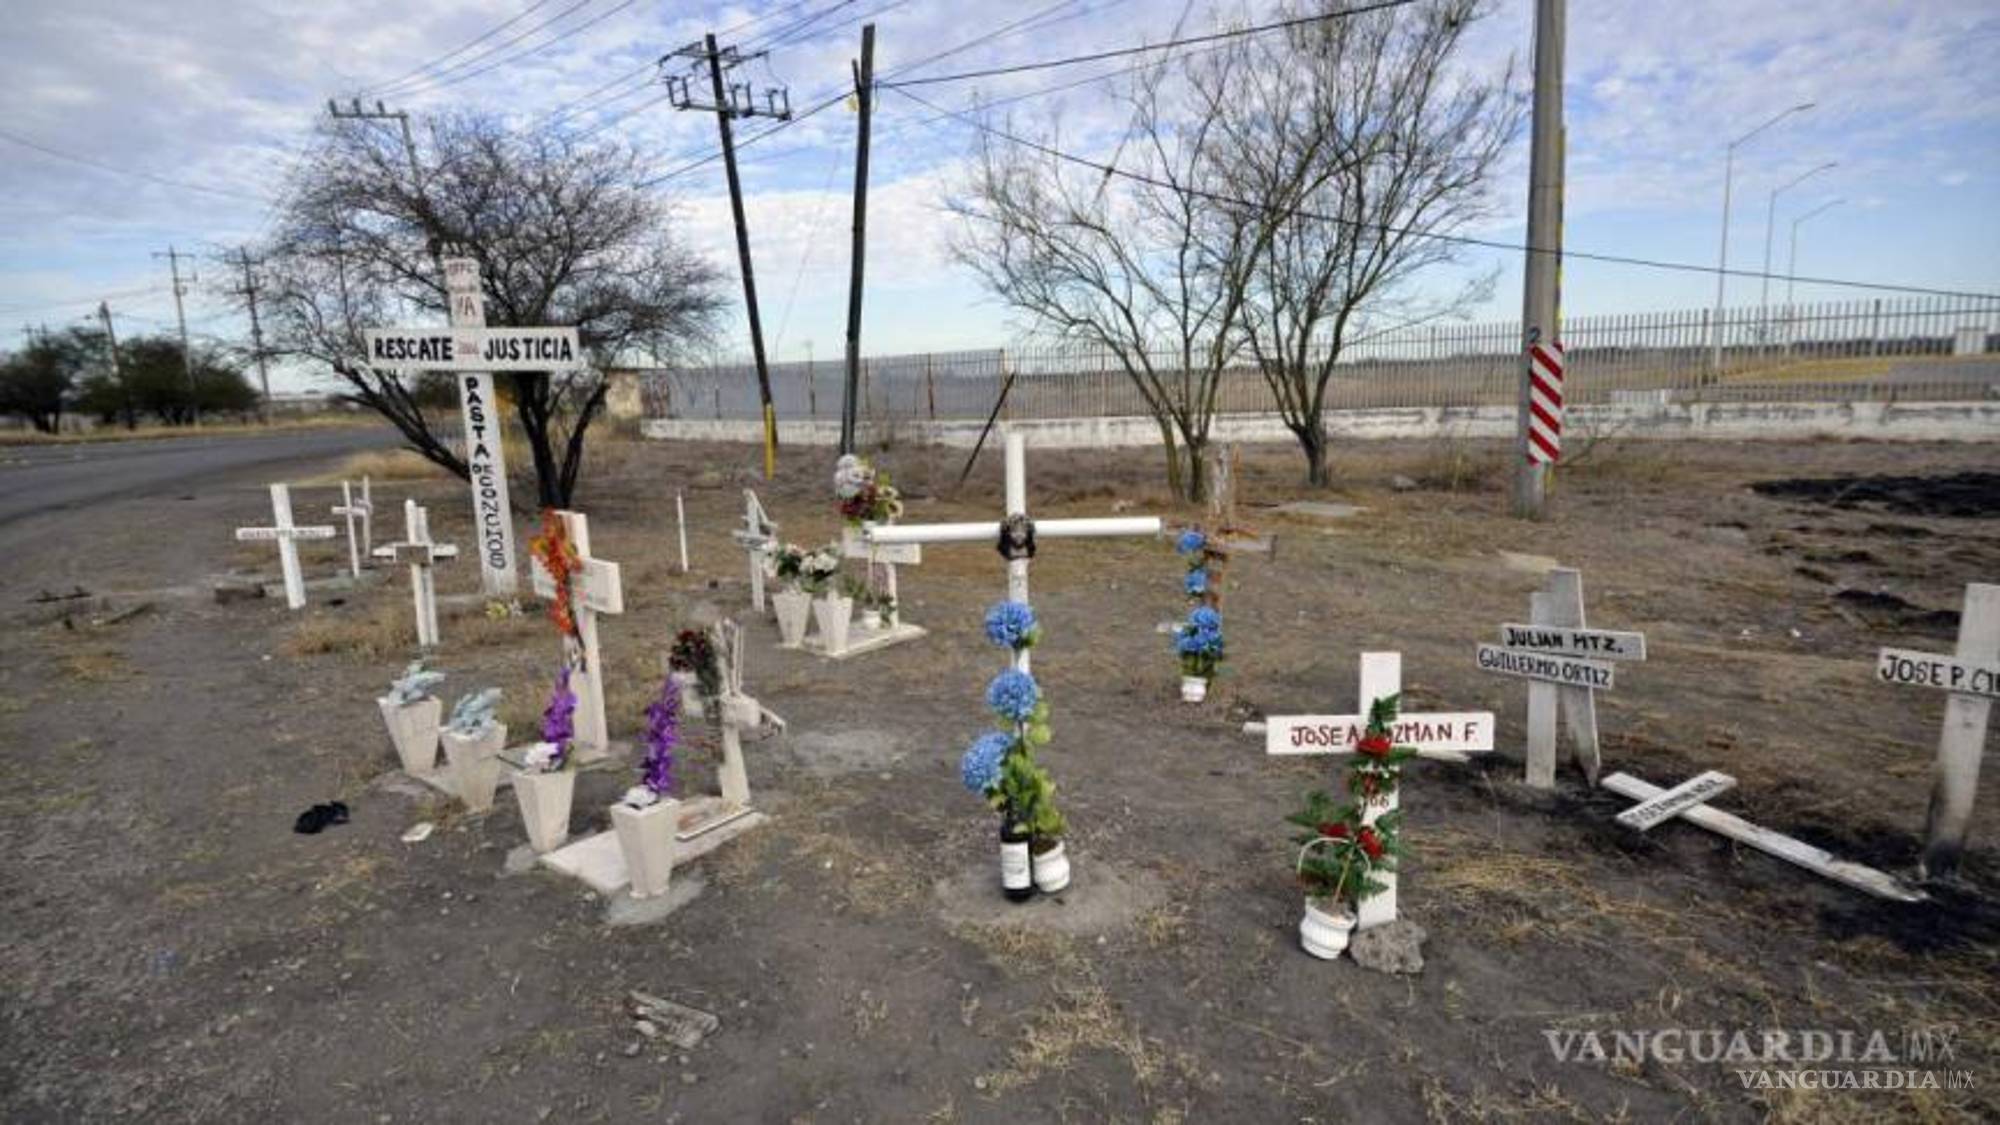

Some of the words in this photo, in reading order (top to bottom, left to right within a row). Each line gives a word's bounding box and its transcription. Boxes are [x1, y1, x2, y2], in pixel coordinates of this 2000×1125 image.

[374, 336, 453, 360] RESCATE
[484, 336, 573, 361] JUSTICIA
[465, 376, 489, 460] PASTA
[479, 475, 506, 570] CONCHOS
[1507, 627, 1563, 648] JULIAN
[1479, 648, 1559, 677] GUILLERMO
[1562, 661, 1610, 686] ORTIZ
[1881, 654, 1945, 686] JOSE
[1290, 724, 1343, 747] JOSE
[1364, 721, 1453, 744] ZMAN
